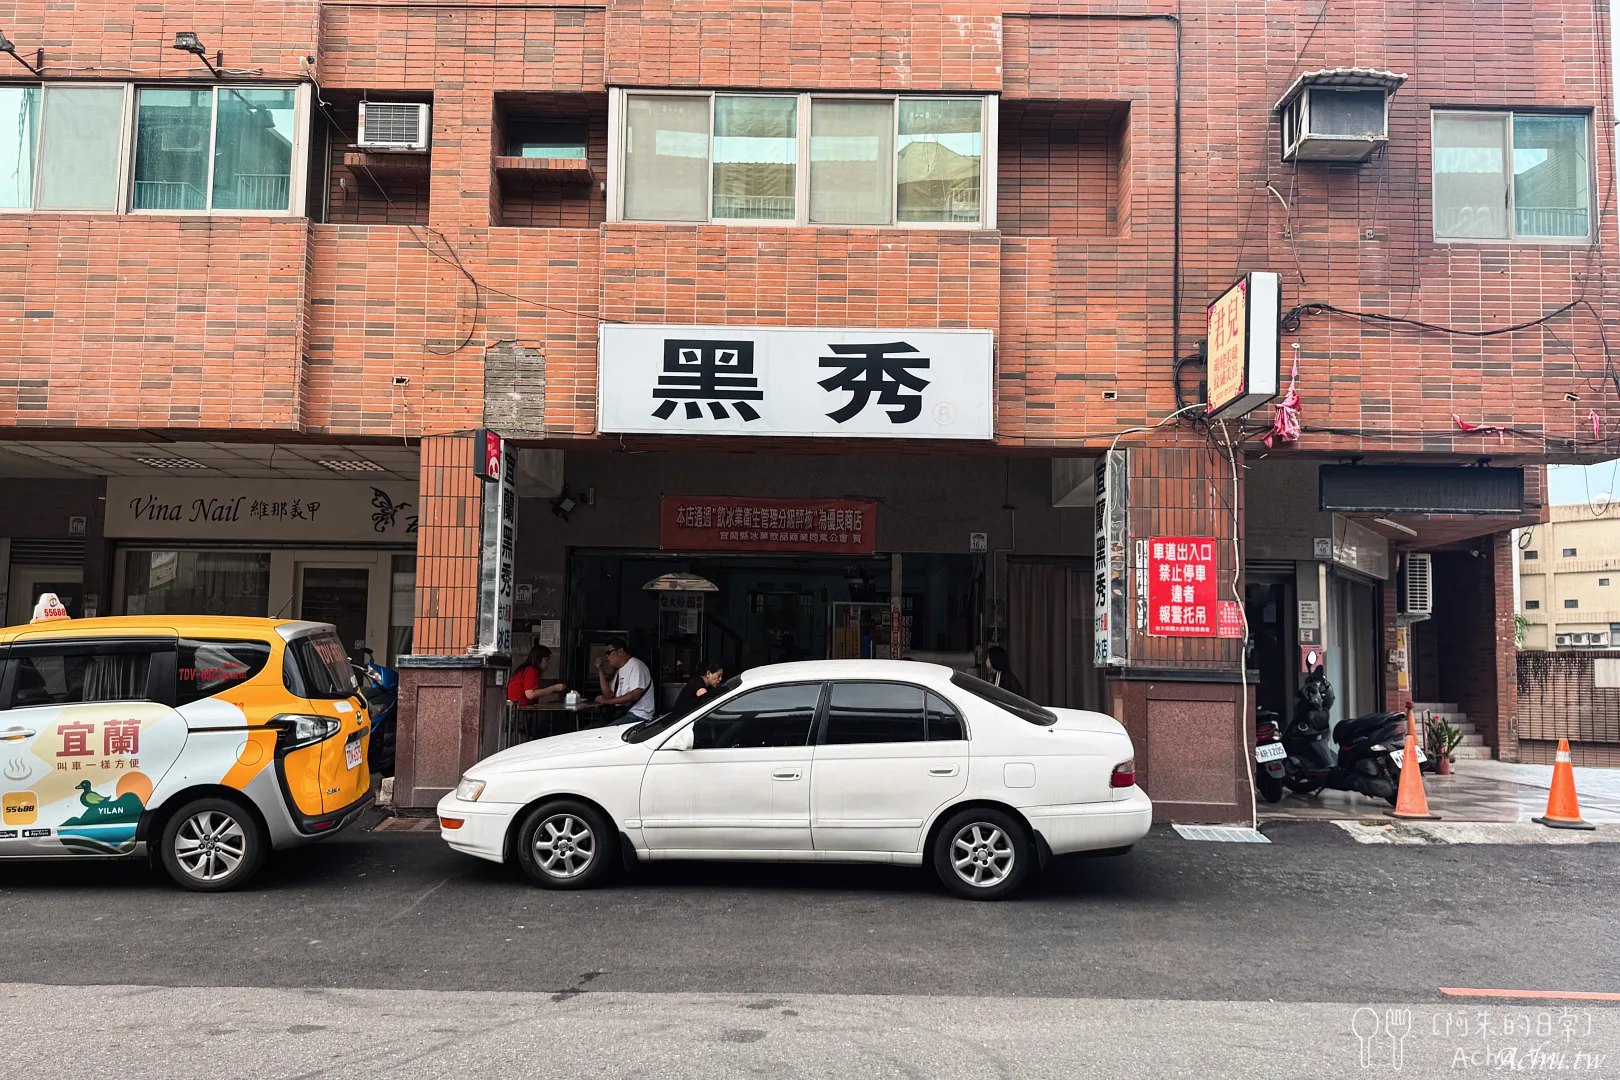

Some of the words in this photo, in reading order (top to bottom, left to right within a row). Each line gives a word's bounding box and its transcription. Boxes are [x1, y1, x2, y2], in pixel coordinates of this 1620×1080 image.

[651, 339, 930, 424] 黑秀
[130, 494, 182, 521] Vina
[189, 496, 246, 522] Nail
[250, 500, 320, 521] 維那美甲
[501, 451, 516, 598] 宜蘭黑秀
[1153, 543, 1211, 561] 車道出入口
[1159, 564, 1206, 582] 禁止停車
[1171, 585, 1194, 603] 違者
[44, 609, 66, 617] 55688
[1159, 605, 1206, 624] 報警托吊
[56, 719, 141, 757] 宜蘭
[57, 758, 140, 771] 叫車一樣方便
[6, 804, 35, 813] 55688
[98, 806, 124, 815] YILAN
